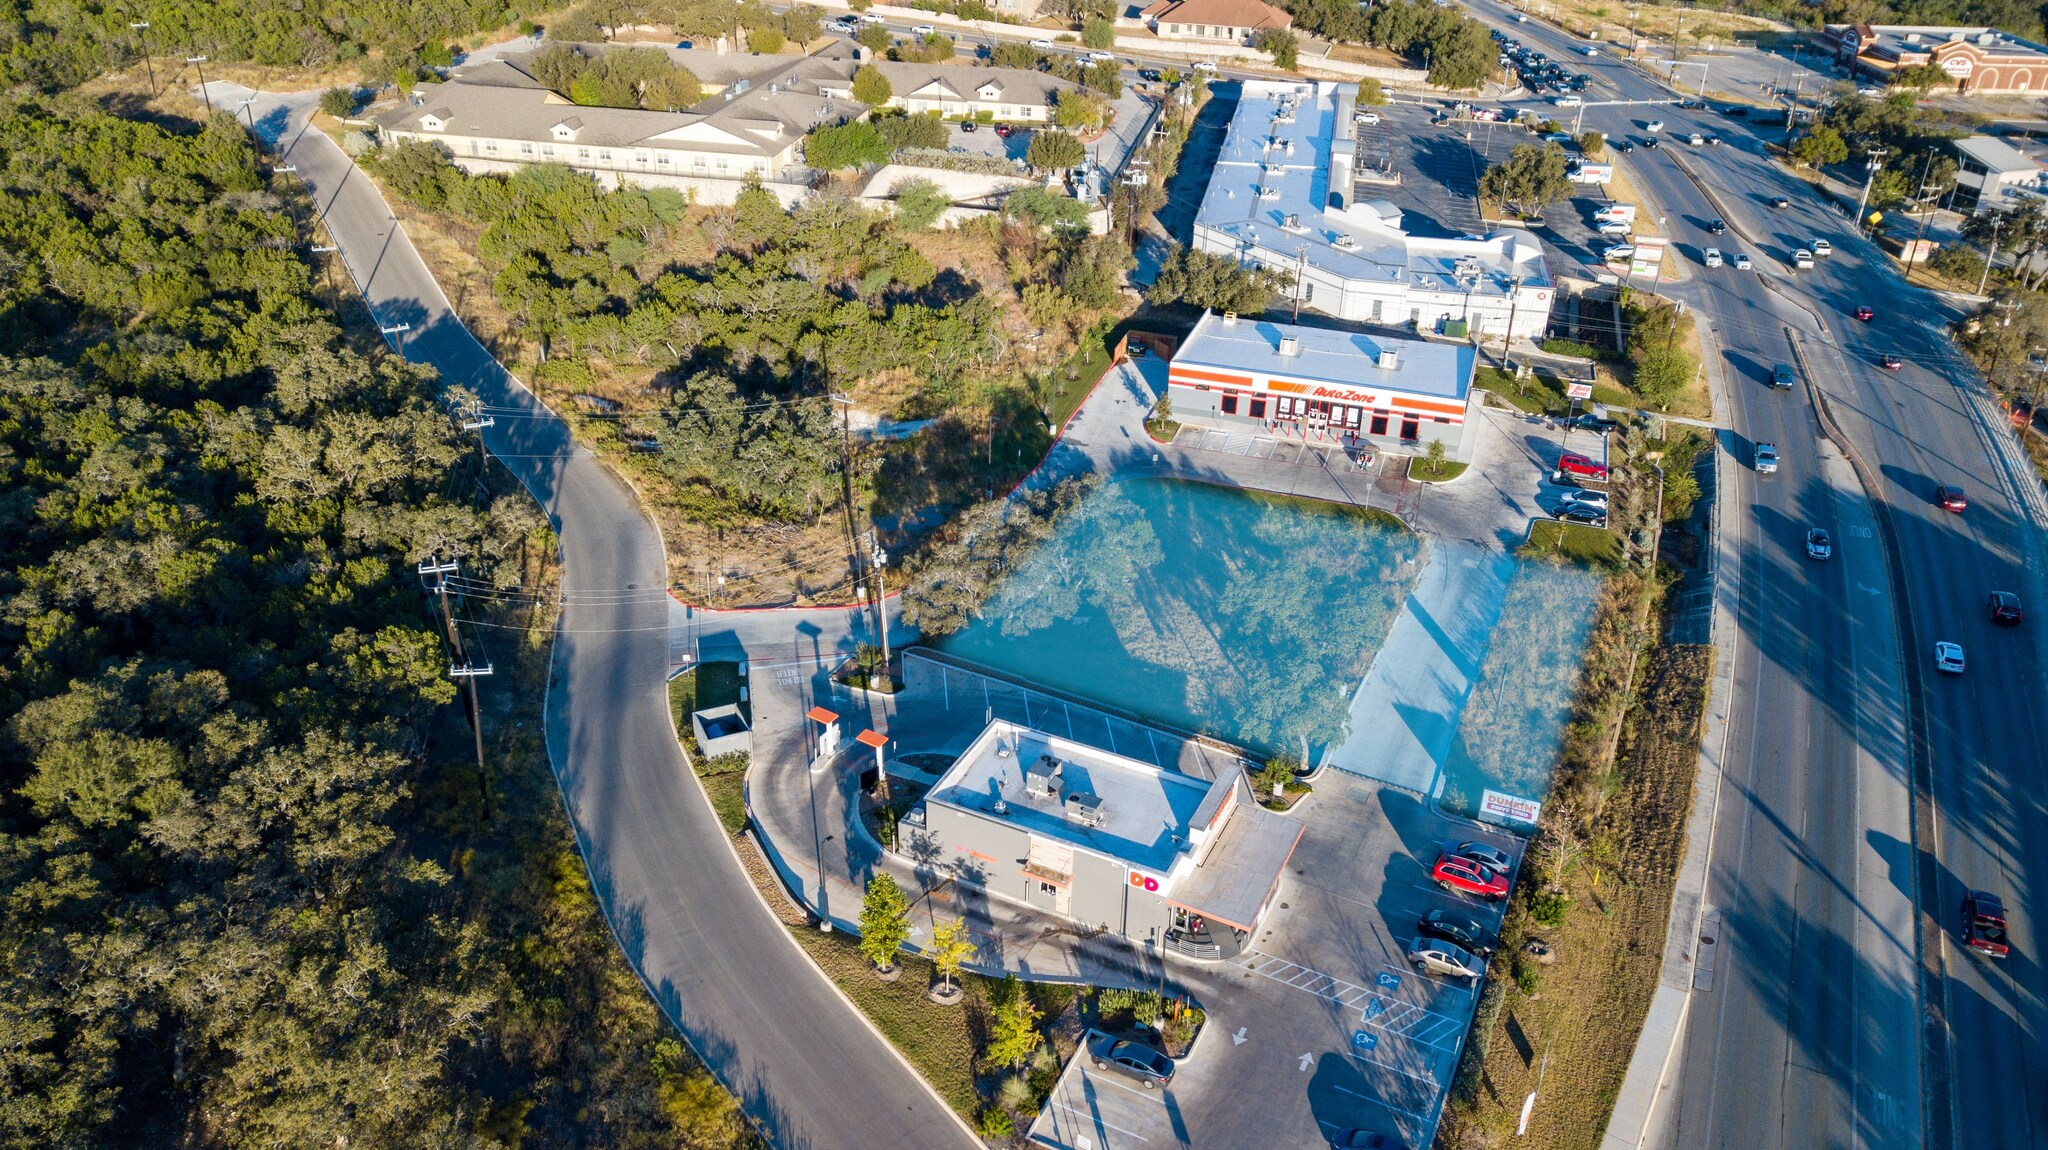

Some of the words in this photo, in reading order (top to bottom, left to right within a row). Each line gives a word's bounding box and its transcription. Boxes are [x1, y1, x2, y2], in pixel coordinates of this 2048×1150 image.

[1312, 386, 1376, 403] AutoZone
[1850, 525, 1871, 538] ONLY
[776, 669, 800, 678] ENTER
[794, 676, 804, 684] DO
[778, 678, 792, 686] NOT
[1488, 795, 1536, 812] DUNKIN'
[1130, 871, 1159, 892] DD
